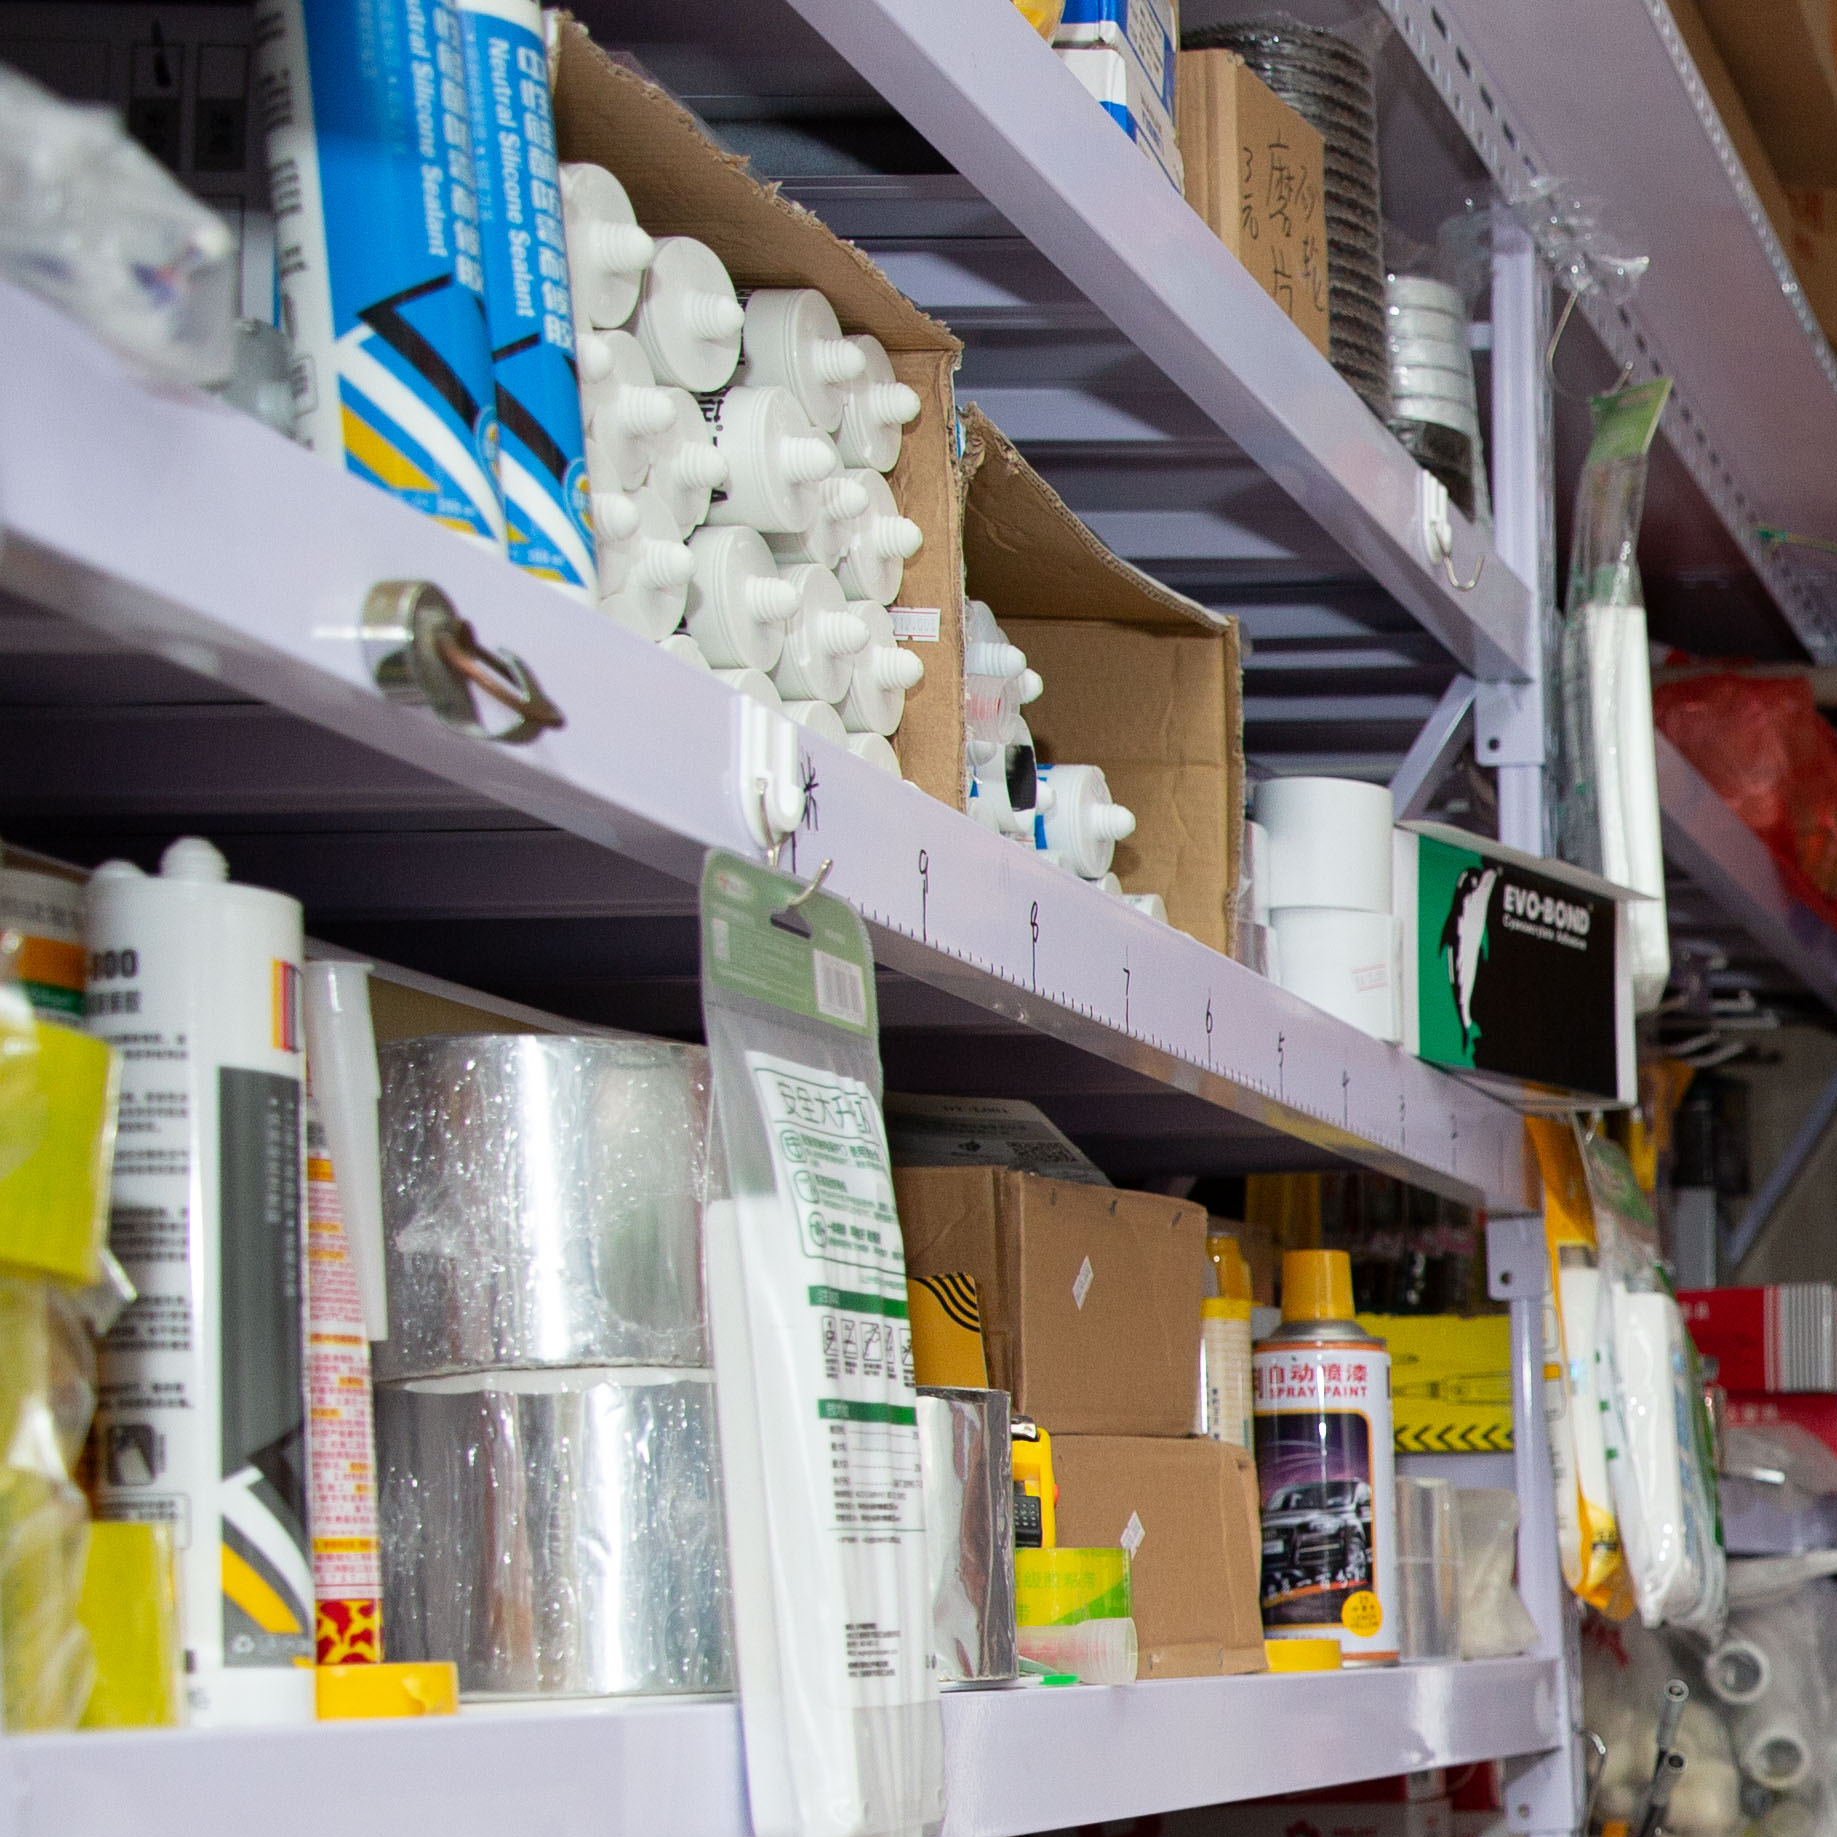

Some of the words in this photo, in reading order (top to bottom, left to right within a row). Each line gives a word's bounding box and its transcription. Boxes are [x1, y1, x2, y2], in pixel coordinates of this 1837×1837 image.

[489, 36, 518, 128] Neutral
[498, 131, 524, 225] Silicone
[508, 228, 536, 318] Sealant
[1269, 1363, 1368, 1384] 自动喷漆
